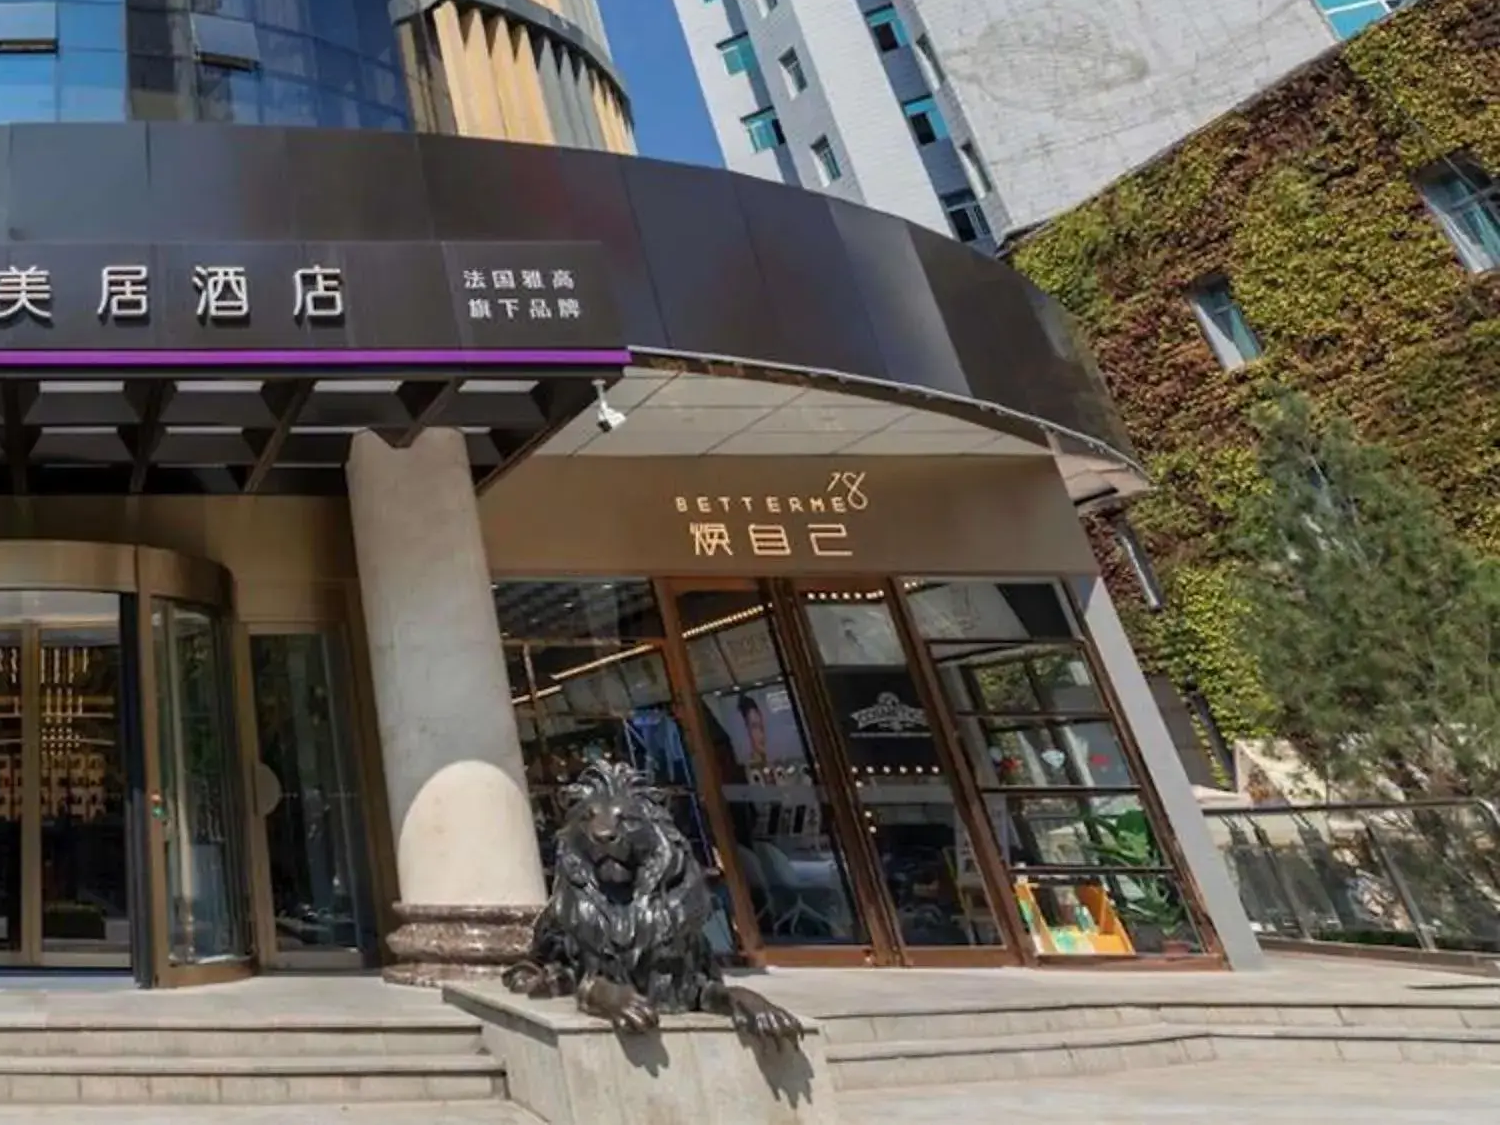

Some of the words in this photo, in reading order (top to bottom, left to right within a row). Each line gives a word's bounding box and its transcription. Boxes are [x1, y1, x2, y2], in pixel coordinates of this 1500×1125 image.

[463, 269, 575, 290] 法国雅高
[468, 298, 580, 319] 旗下品牌
[675, 496, 847, 513] BETTERME
